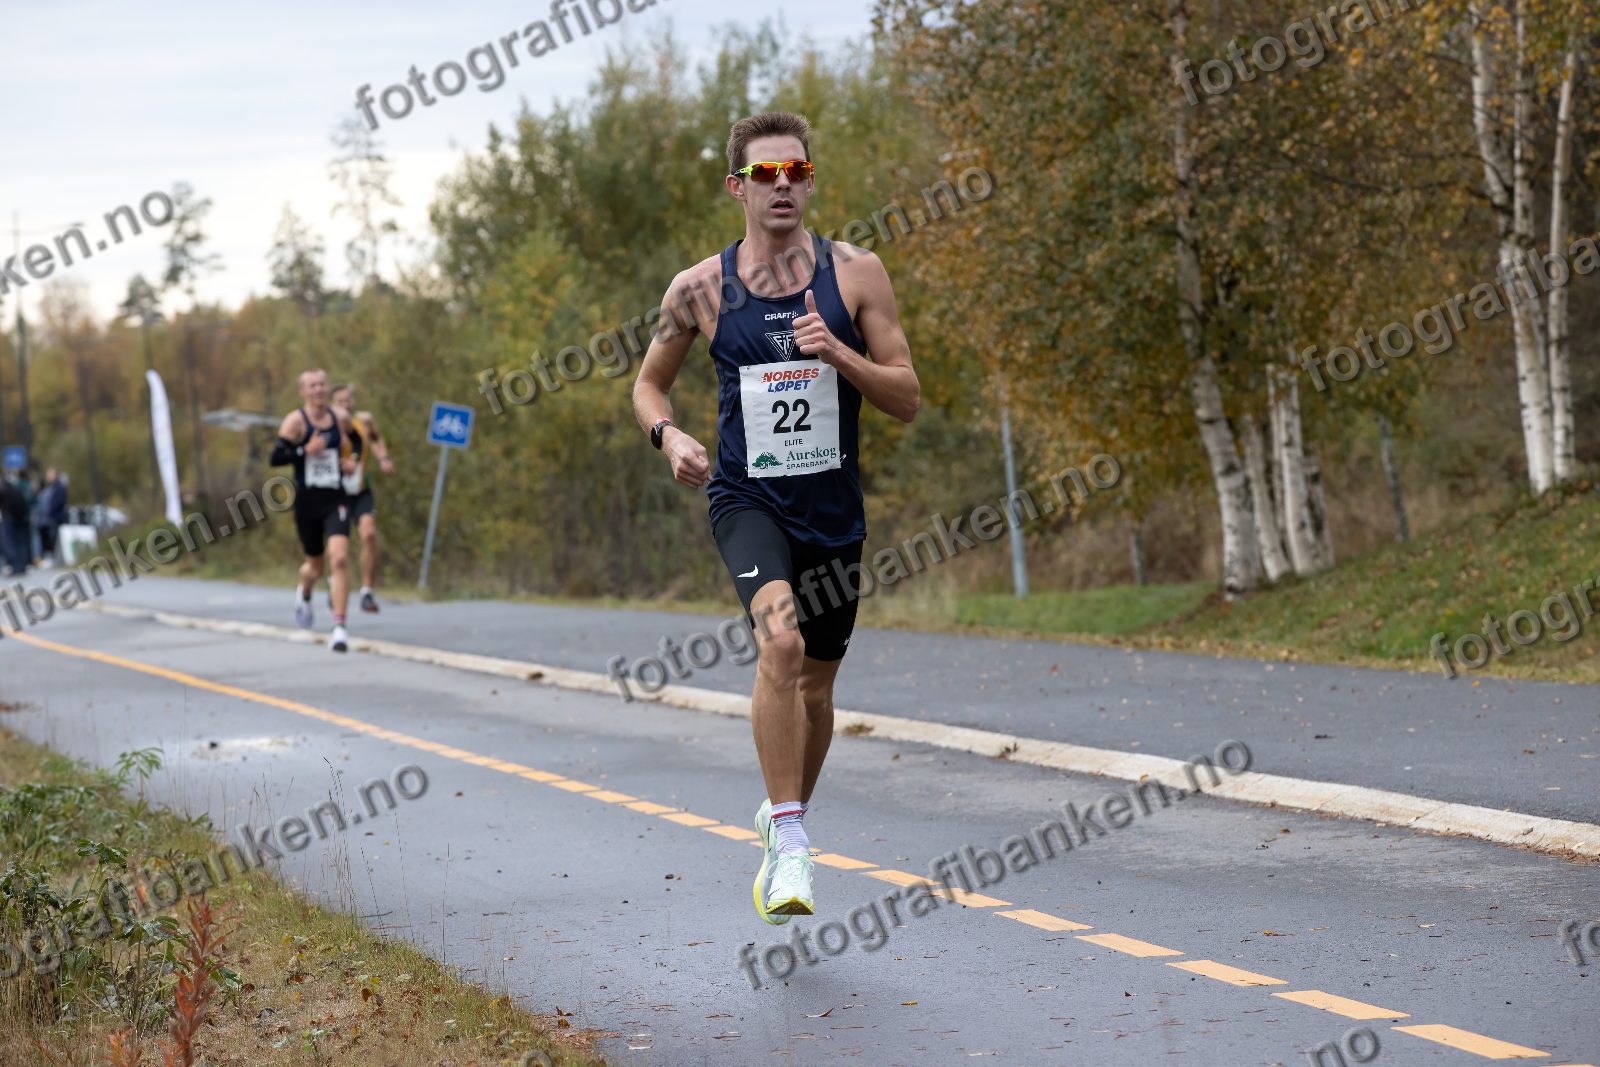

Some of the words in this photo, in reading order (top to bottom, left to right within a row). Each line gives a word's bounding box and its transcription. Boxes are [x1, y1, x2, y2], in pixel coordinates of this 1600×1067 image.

[764, 312, 791, 321] CRAFT
[761, 368, 819, 383] NORGES
[767, 380, 810, 393] LØPET
[771, 398, 811, 434] 22
[784, 438, 803, 447] ELITE
[786, 446, 837, 462] Aurskog
[786, 460, 829, 470] SPAREBANK
